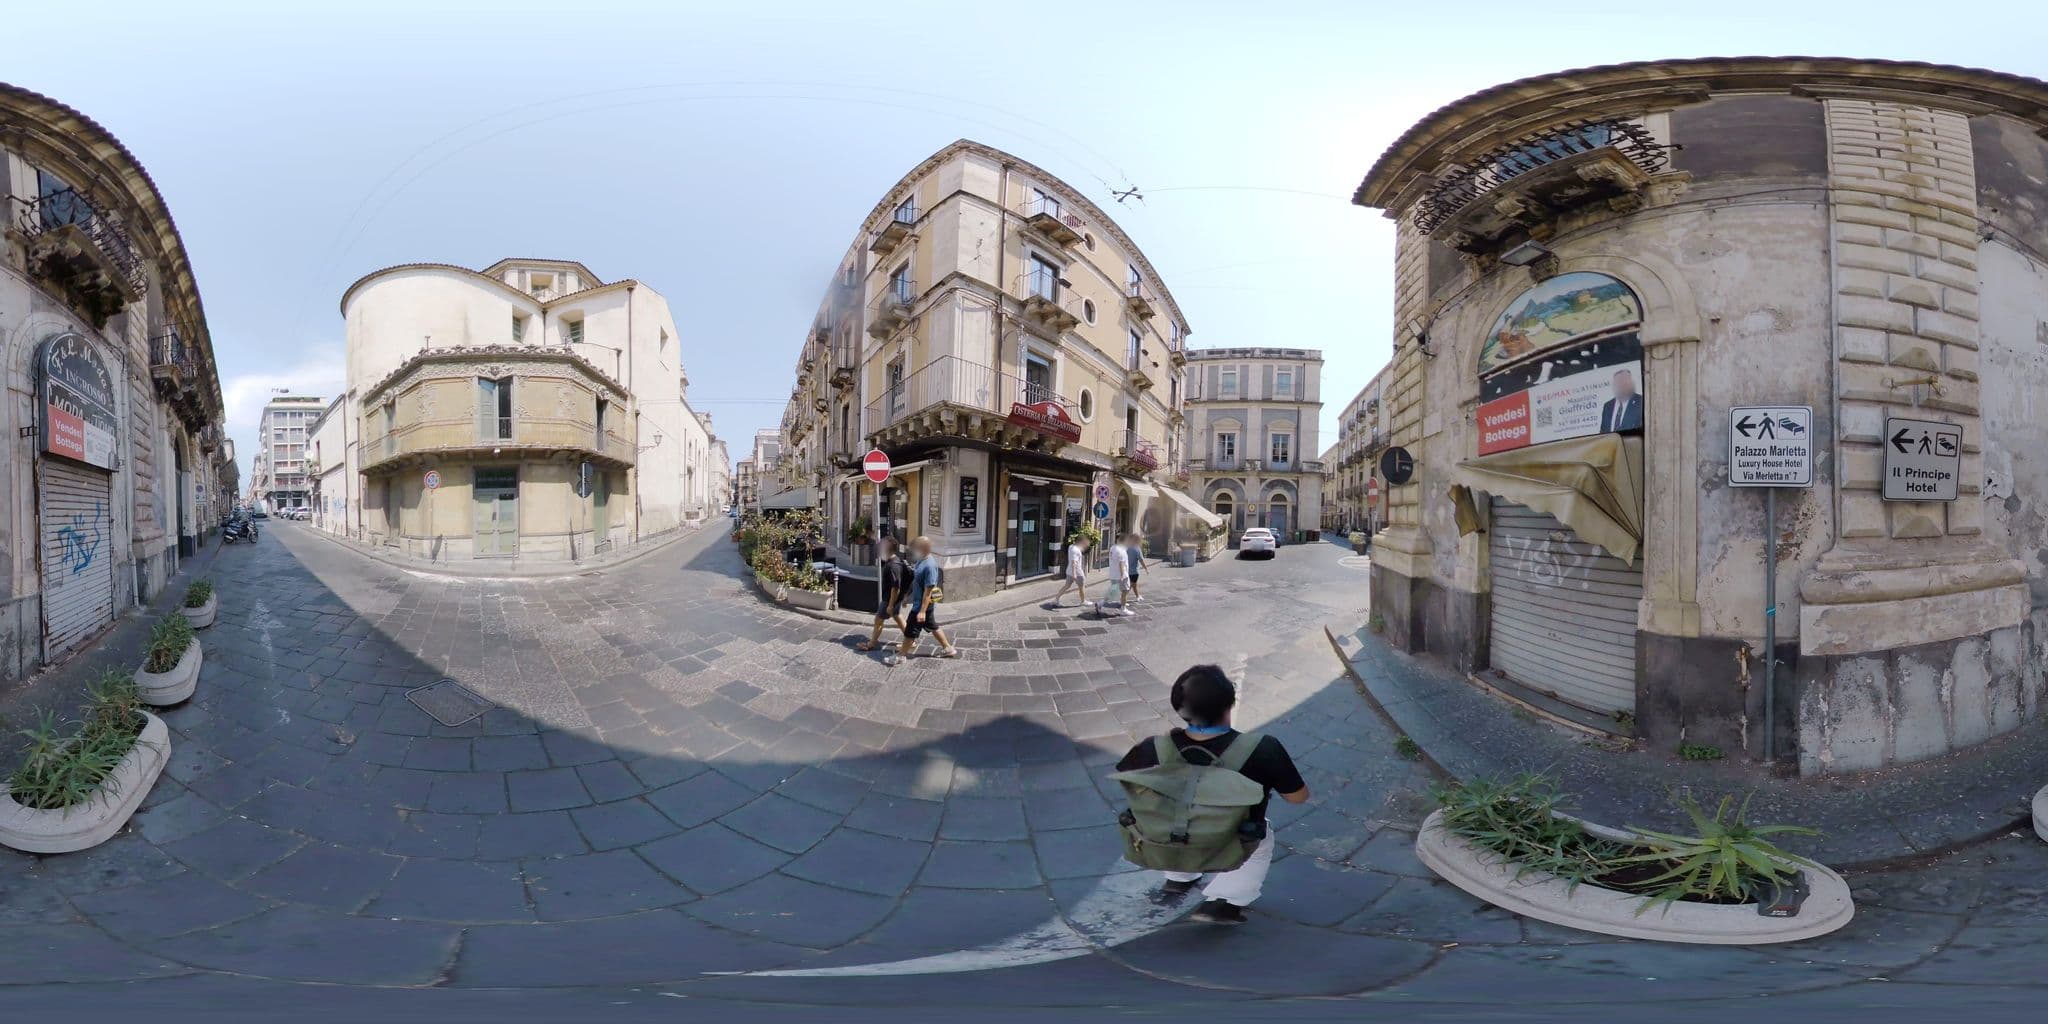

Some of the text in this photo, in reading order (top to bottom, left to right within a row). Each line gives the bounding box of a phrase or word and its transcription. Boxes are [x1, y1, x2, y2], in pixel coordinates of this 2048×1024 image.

[65, 367, 107, 406] INGROSSO
[54, 395, 85, 420] MODA
[1014, 405, 1040, 420] OSTERIA
[1559, 400, 1598, 415] Giuffrida
[1484, 404, 1526, 428] Vendesi
[55, 419, 82, 439] Vendesi
[1485, 424, 1527, 443] Bottega
[55, 434, 83, 452] Bottega
[1735, 446, 1807, 457] Palazzo Marletta
[1738, 459, 1803, 470] Luxury House Hotel
[1743, 471, 1754, 480] Via
[1793, 472, 1798, 480] 7
[1893, 467, 1951, 480] Il Principe
[1906, 481, 1937, 493] Hotel
